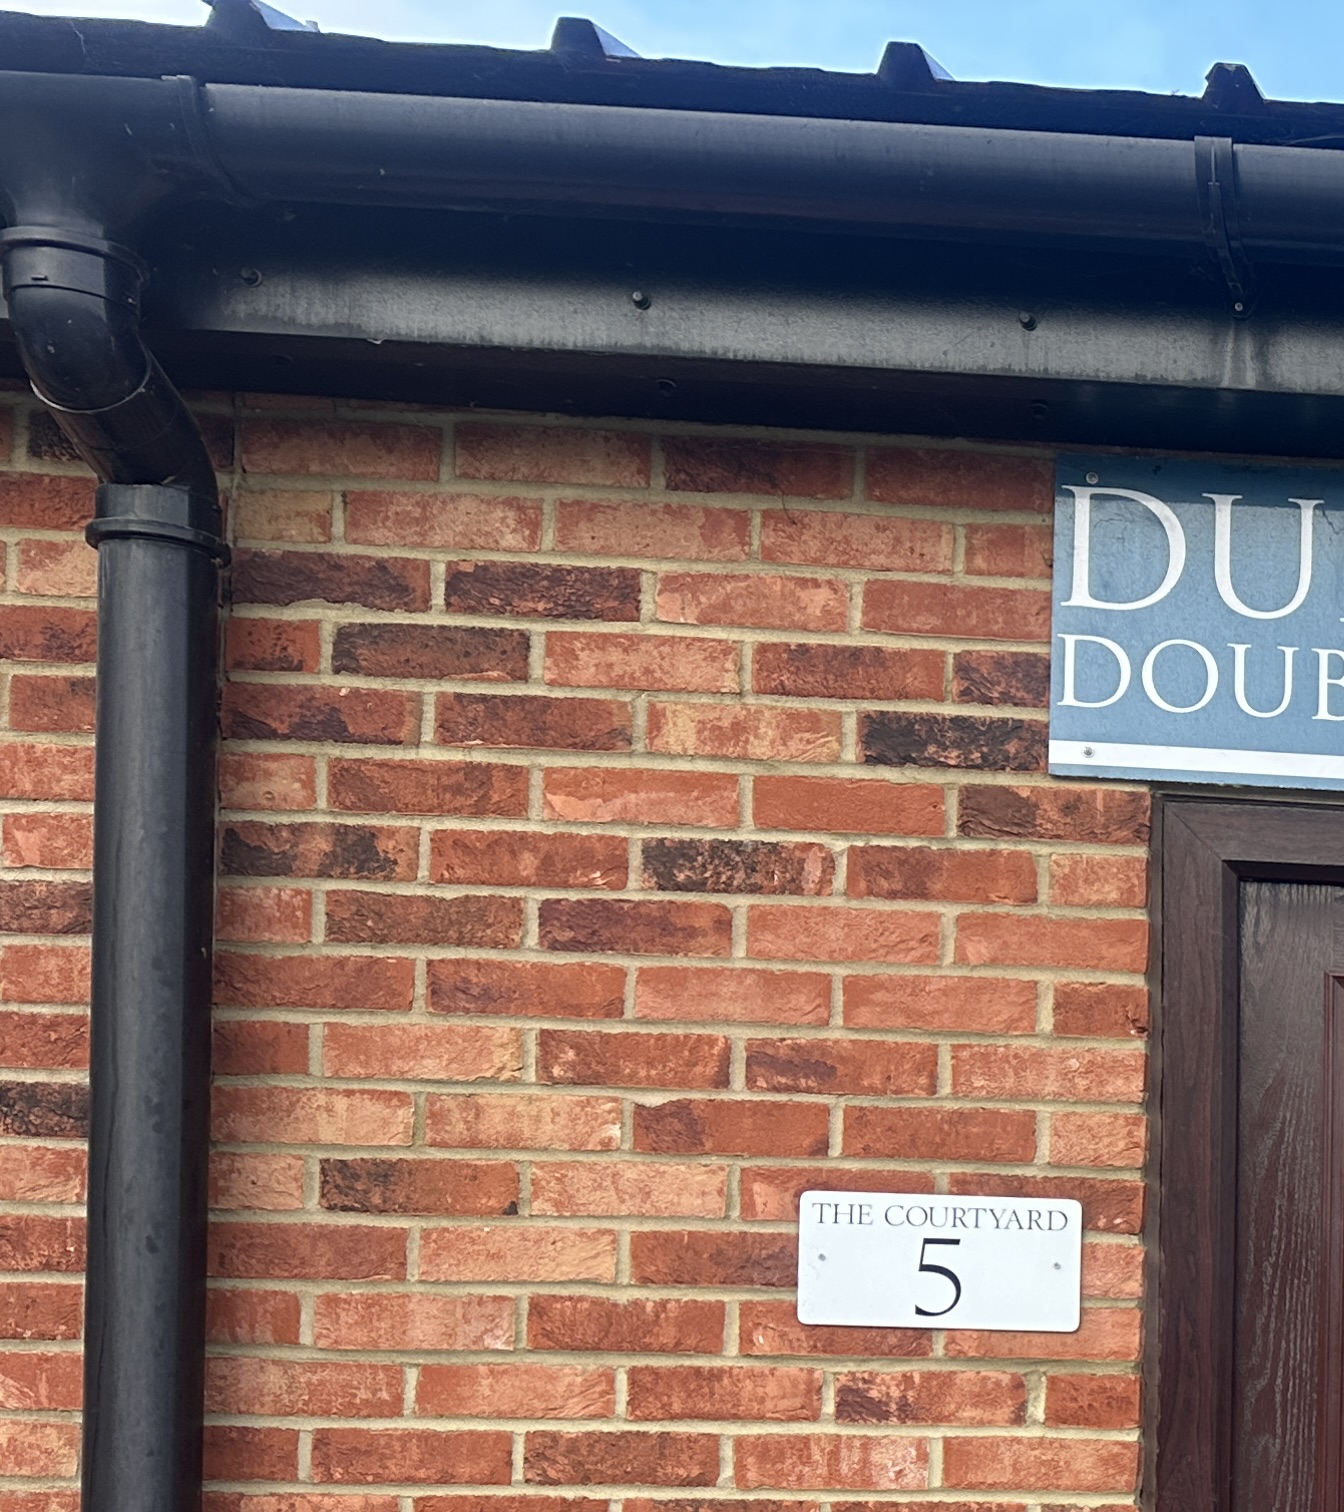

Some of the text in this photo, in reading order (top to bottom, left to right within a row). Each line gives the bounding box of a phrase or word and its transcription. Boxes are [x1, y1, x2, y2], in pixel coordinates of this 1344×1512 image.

[812, 1202, 1068, 1232] THE COURTYARD
[915, 1238, 962, 1317] 5
